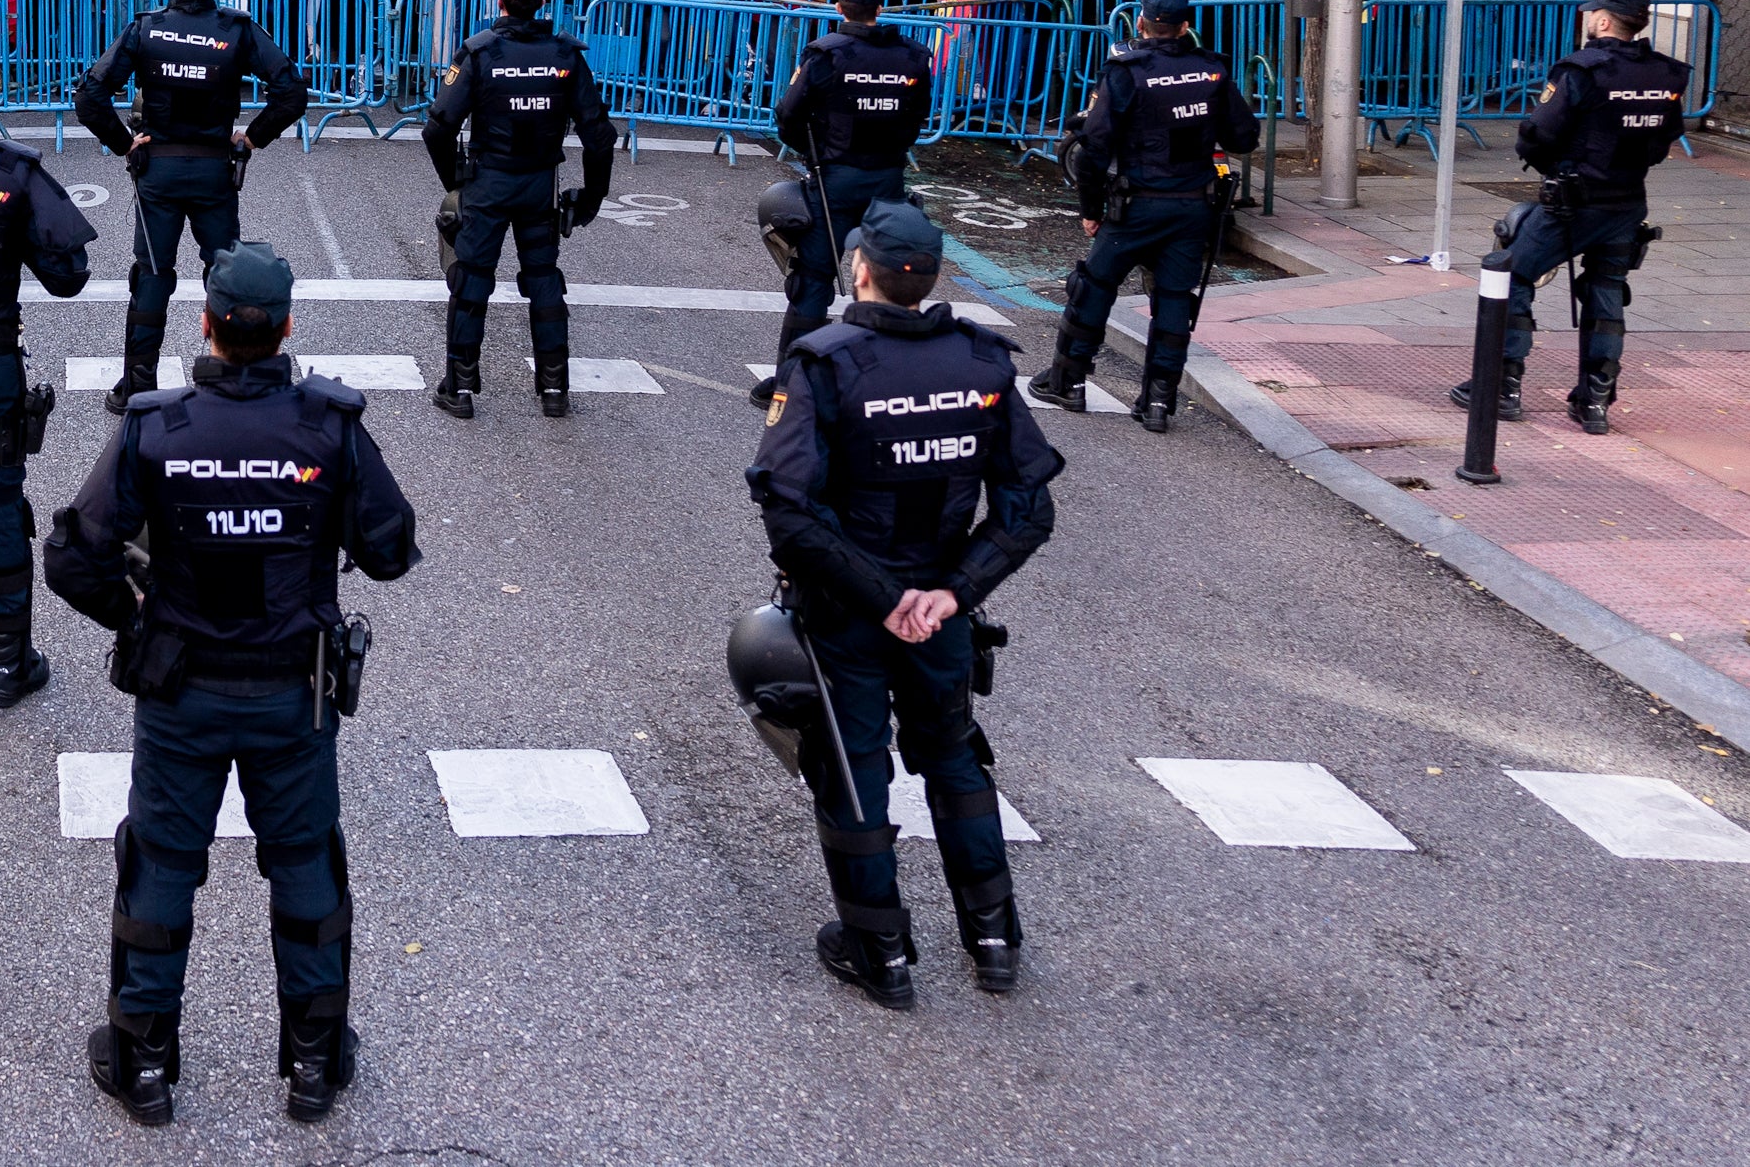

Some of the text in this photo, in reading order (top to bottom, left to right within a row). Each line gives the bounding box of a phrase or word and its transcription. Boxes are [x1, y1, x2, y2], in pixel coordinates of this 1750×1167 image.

[149, 29, 217, 47] POLICIA
[161, 63, 207, 80] 11U122
[491, 66, 559, 78] POLICIA
[844, 73, 908, 84] POLICIA
[1146, 71, 1212, 88] POLICIA
[1609, 90, 1672, 100] POLICIA
[509, 97, 551, 111] 11U121
[857, 98, 899, 111] 11U151
[1172, 102, 1209, 119] 11U12
[864, 389, 985, 418] POLICIA
[891, 435, 977, 464] 11U130
[164, 459, 302, 480] POLICIA
[206, 508, 283, 535] 11U10
